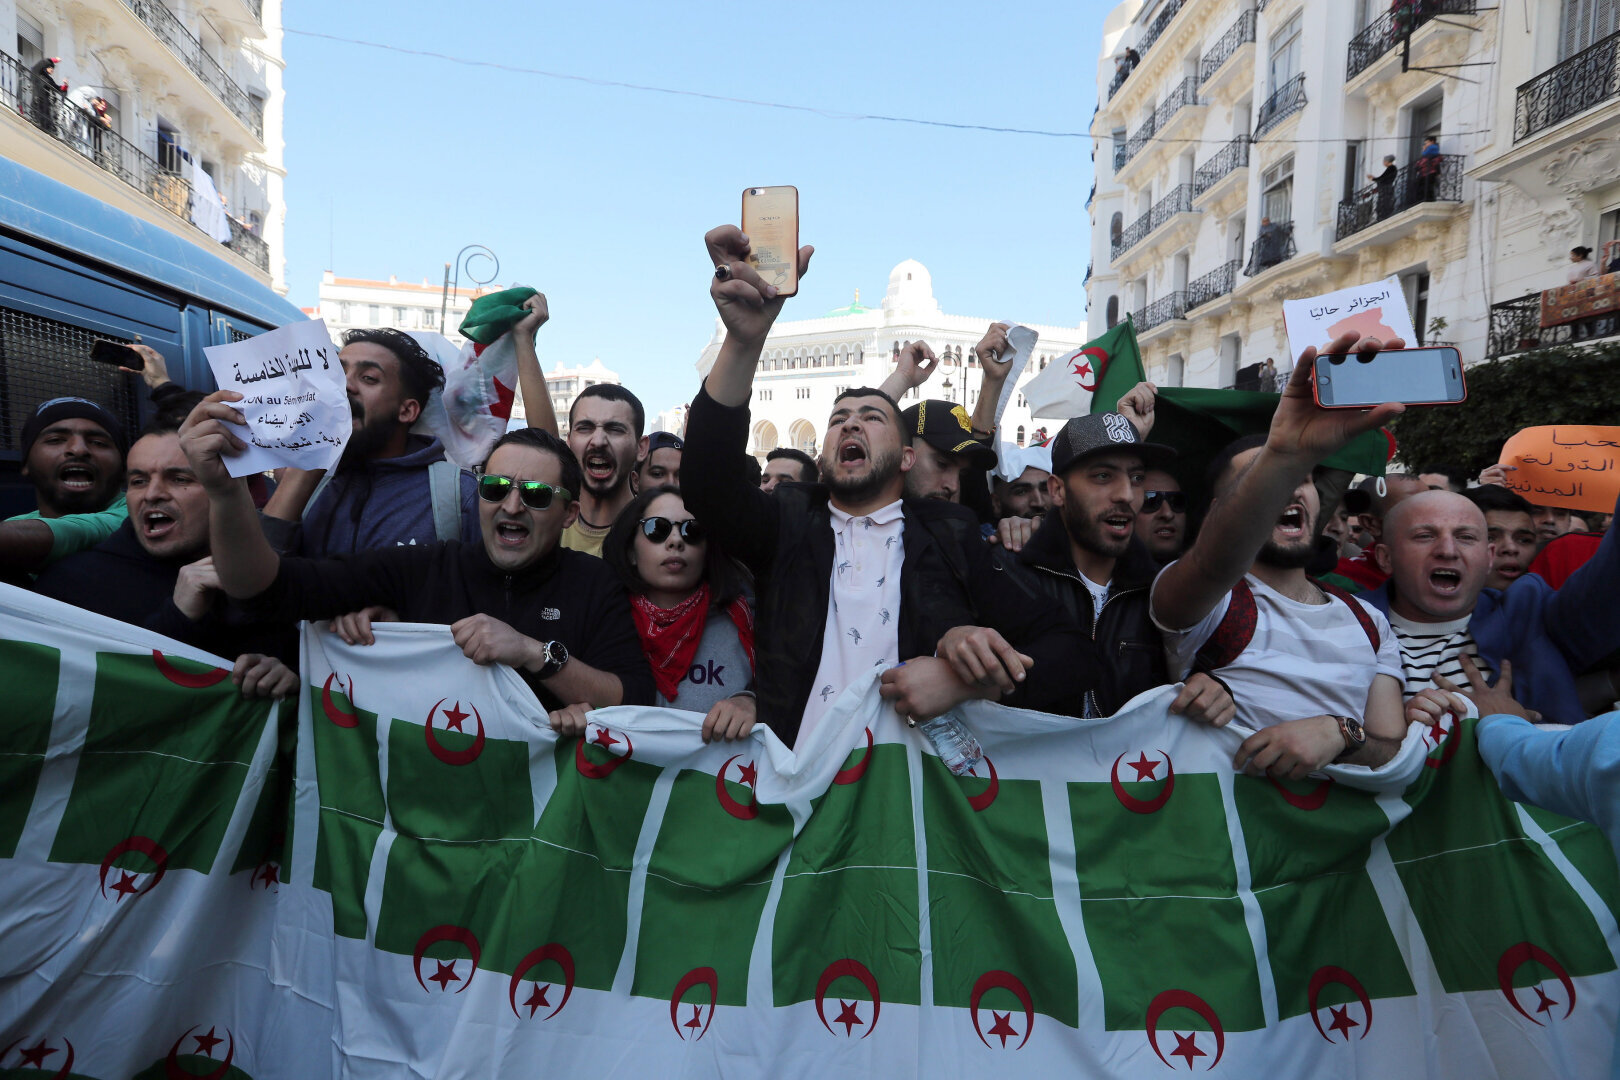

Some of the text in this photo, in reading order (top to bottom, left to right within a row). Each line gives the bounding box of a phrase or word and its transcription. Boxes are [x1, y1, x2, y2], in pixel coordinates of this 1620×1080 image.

[1347, 291, 1390, 312] الجزائر
[316, 347, 329, 370] لا
[233, 357, 288, 384] الخامسة
[266, 397, 281, 405] au
